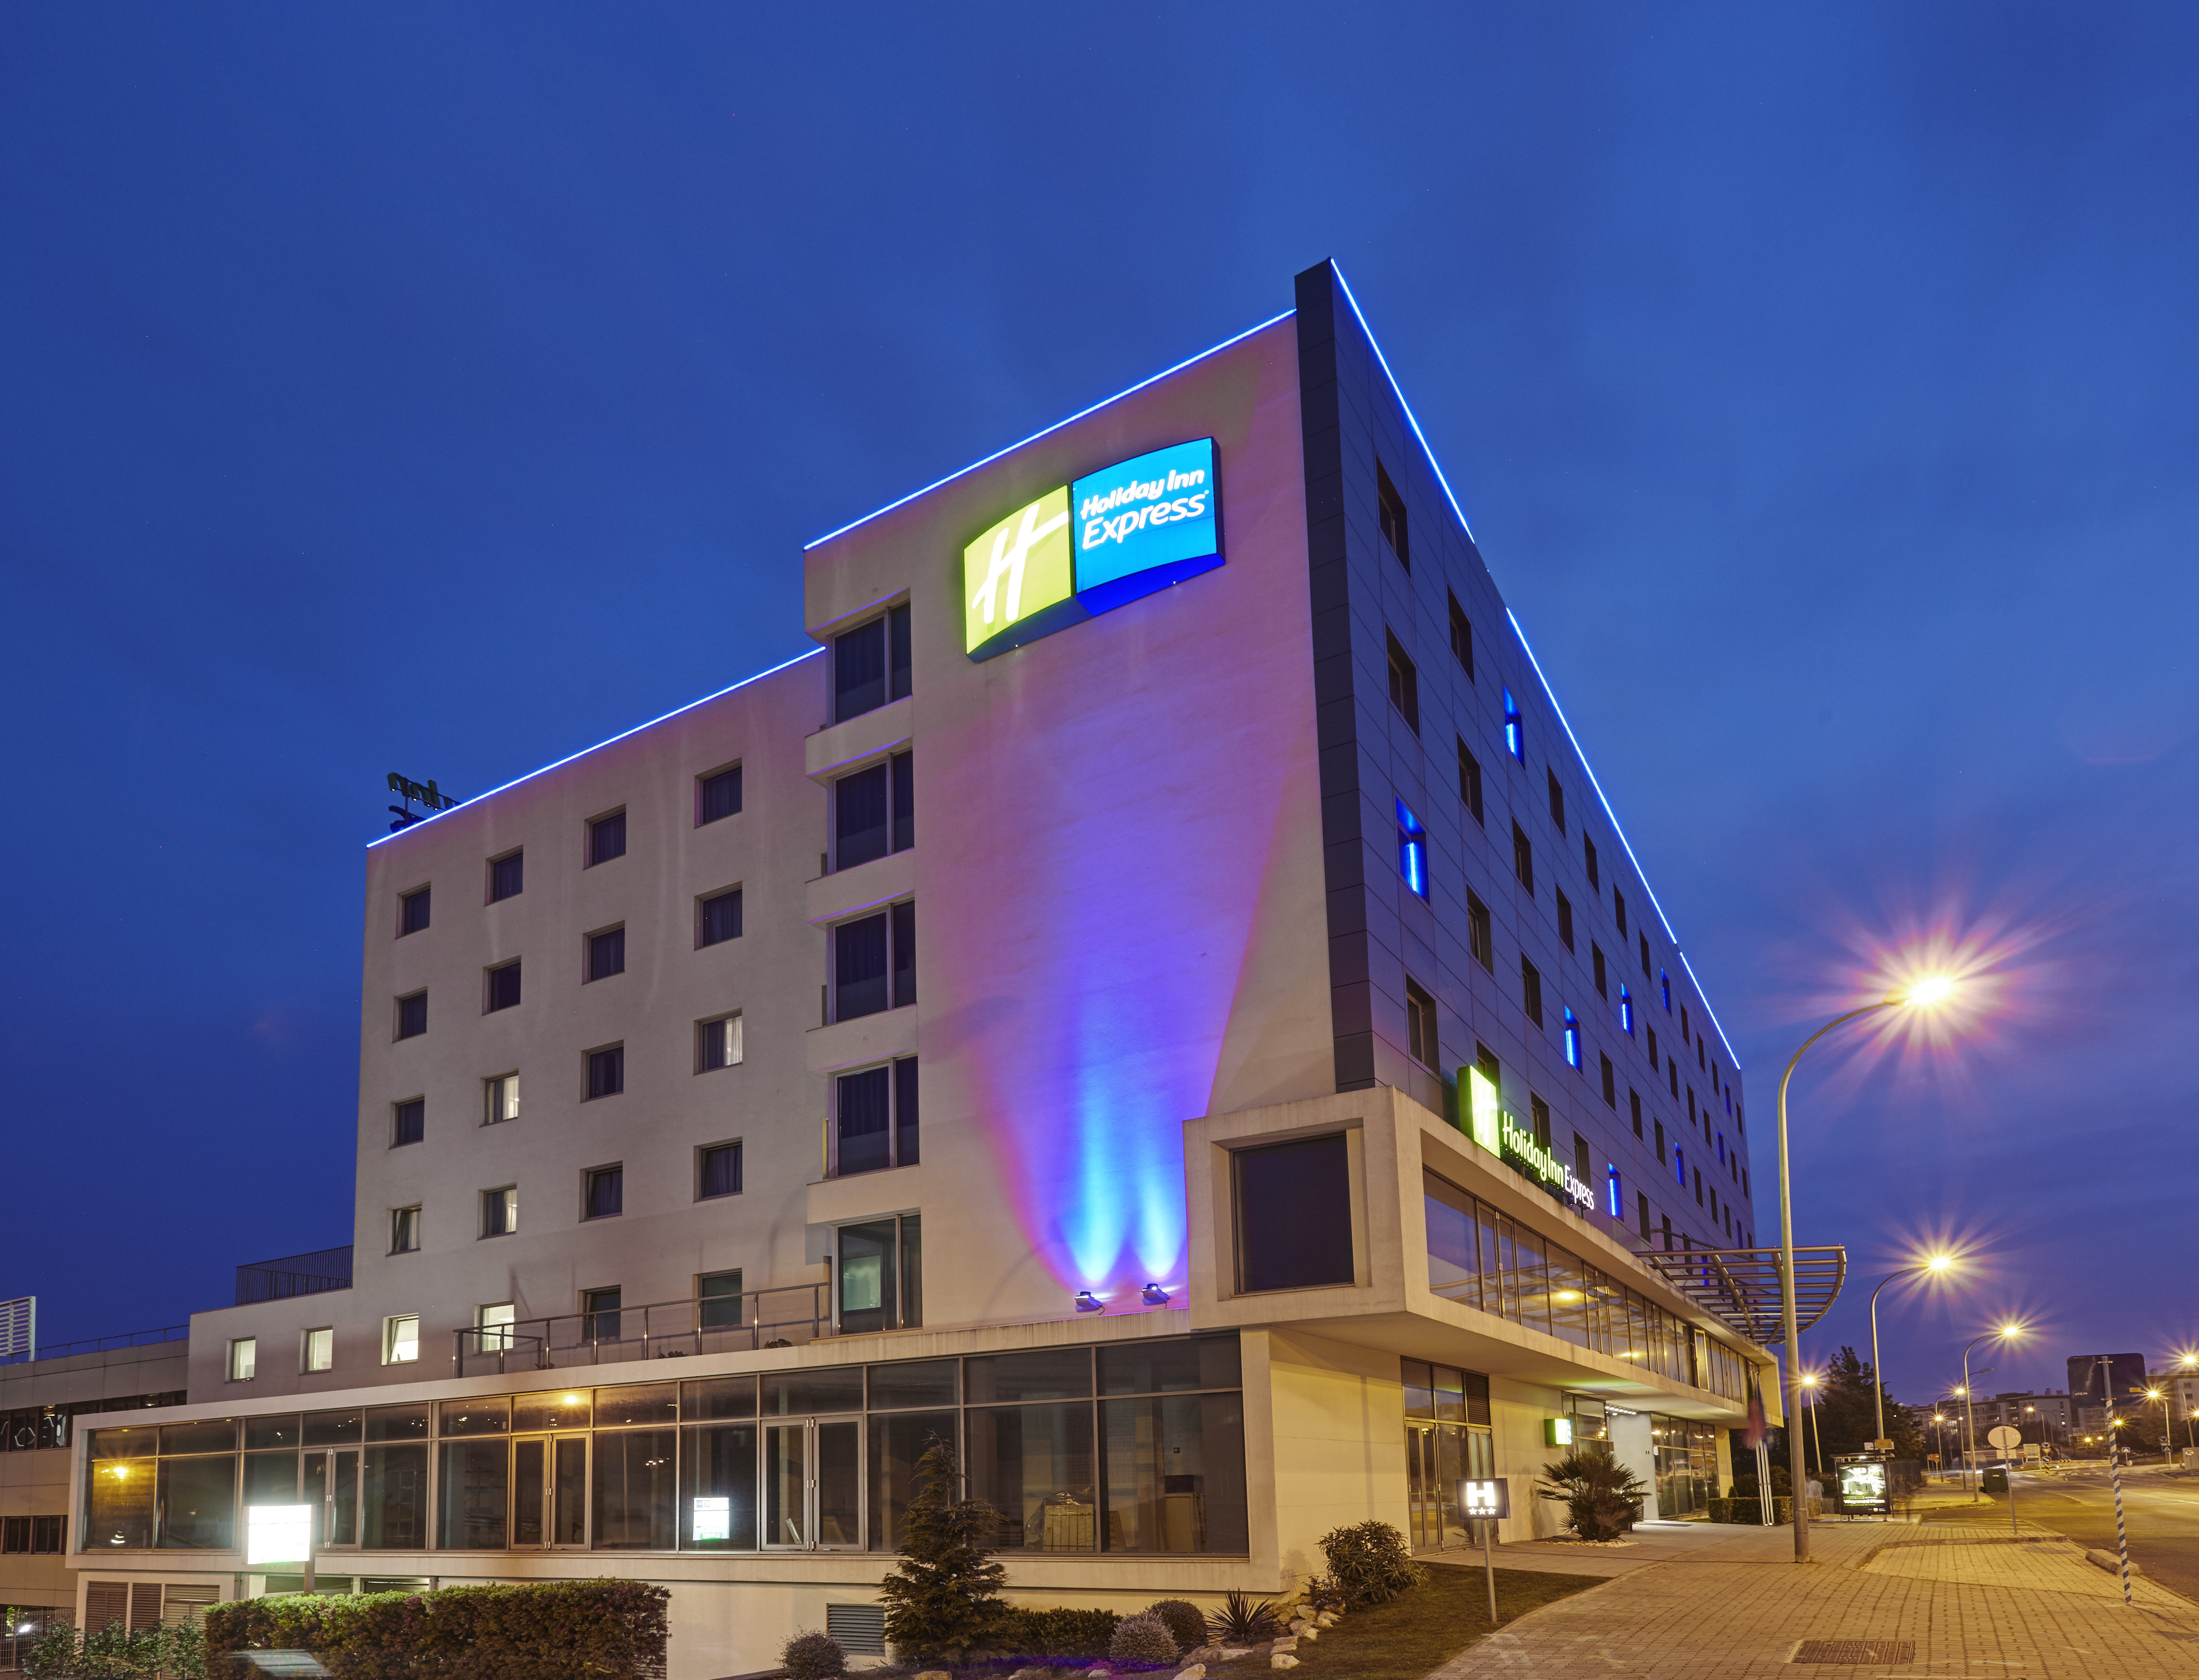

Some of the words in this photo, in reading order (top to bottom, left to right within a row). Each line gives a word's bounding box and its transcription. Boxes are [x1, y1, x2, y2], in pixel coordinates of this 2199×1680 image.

[1080, 478, 1165, 519] Holiday
[1167, 470, 1205, 491] Inn
[1082, 493, 1206, 550] Express
[1502, 1111, 1547, 1181] Holiday
[1547, 1147, 1564, 1188] Inn
[1564, 1165, 1595, 1210] Express
[1467, 1482, 1495, 1506] H
